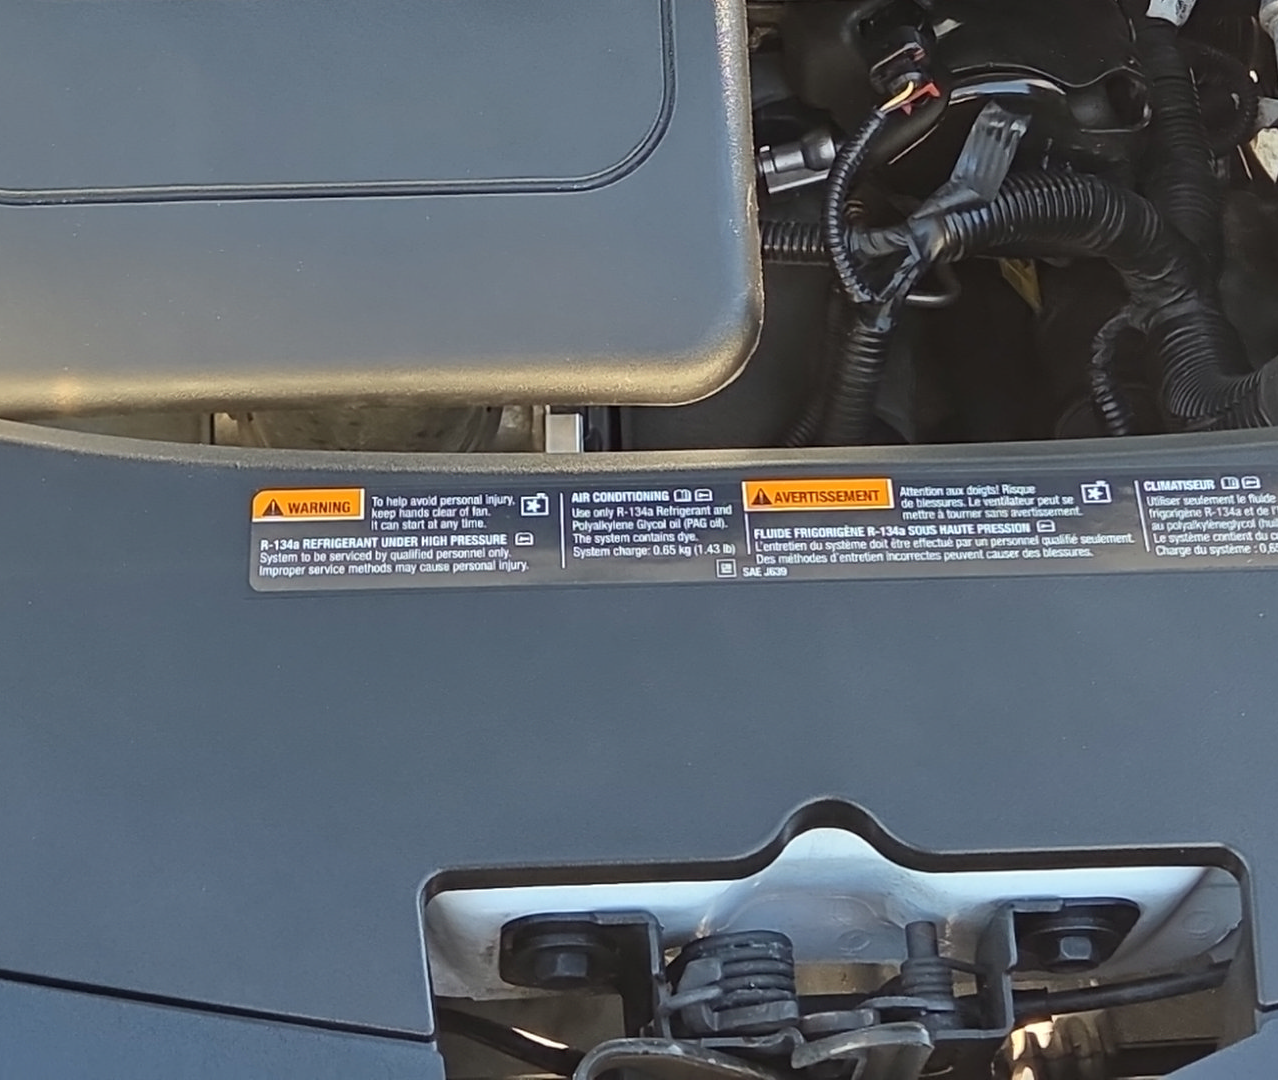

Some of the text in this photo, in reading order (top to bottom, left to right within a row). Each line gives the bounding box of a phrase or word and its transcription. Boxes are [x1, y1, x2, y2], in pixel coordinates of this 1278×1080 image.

[899, 486, 944, 497] Attention
[946, 488, 964, 496] aux
[1001, 485, 1036, 497] Risque
[1143, 480, 1215, 491] CLIMATISEUR
[386, 496, 408, 508] help
[410, 496, 437, 506] avoid
[440, 495, 482, 507] personal
[571, 491, 670, 503] AIR CONDITIONING
[774, 489, 880, 503] AVERTISSEMENT
[916, 497, 966, 508] blessures.
[982, 496, 1035, 507] ventilateur
[1036, 496, 1060, 508] peut
[1182, 495, 1235, 506] seulement
[1247, 494, 1276, 504] fluide
[288, 501, 351, 515] WARNING
[371, 508, 396, 520] keep
[399, 508, 429, 518] hands
[432, 508, 457, 518] clear
[472, 508, 491, 518] fan.
[572, 505, 732, 519] Use only R-134a Refrigerant and
[902, 509, 935, 520] mettre
[946, 509, 982, 519] tourner
[984, 510, 1009, 519] sans
[1010, 507, 1083, 518] avertissement.
[1204, 507, 1242, 517] R-134a
[380, 522, 399, 530] can
[402, 520, 425, 530] start
[440, 521, 458, 531] any
[461, 519, 487, 529] time.
[572, 520, 634, 532] Polyalkylene
[636, 519, 666, 531] Glycol
[683, 519, 707, 529] (PAG
[754, 527, 791, 538] FLUIDE
[866, 525, 906, 536] R-134a
[907, 524, 937, 535] SOUS
[939, 524, 975, 534] HAUTE
[976, 522, 1031, 533] PRESSION
[260, 535, 507, 550] R-134a REFRIGERANT UNDER HIGH PRESSURE
[573, 532, 699, 545] The system contains dye.
[825, 539, 867, 551] système
[869, 539, 889, 549] doit
[890, 538, 910, 549] être
[912, 537, 954, 548] effectué
[955, 539, 972, 549] par
[990, 536, 1039, 548] personnel
[1041, 535, 1078, 547] qualifié
[1079, 534, 1136, 545] seulement.
[1168, 532, 1210, 545] système
[1212, 531, 1253, 542] contient
[259, 552, 297, 564] System
[329, 551, 372, 561] serviced
[390, 549, 433, 562] qualified
[436, 549, 485, 561] personnel
[488, 548, 511, 560] only.
[573, 547, 610, 559] System
[613, 546, 650, 558] charge:
[652, 545, 676, 556] 0.65
[693, 545, 720, 555] (1.43
[756, 548, 1094, 564] Des méthodes d'entretien incorrectes peuvent causer des blessures.
[1155, 545, 1191, 557] Charge
[1209, 544, 1251, 556] système
[259, 561, 529, 577] Improper service methods may cause personal injury.
[742, 567, 762, 577] SAE
[763, 566, 787, 577] J639
